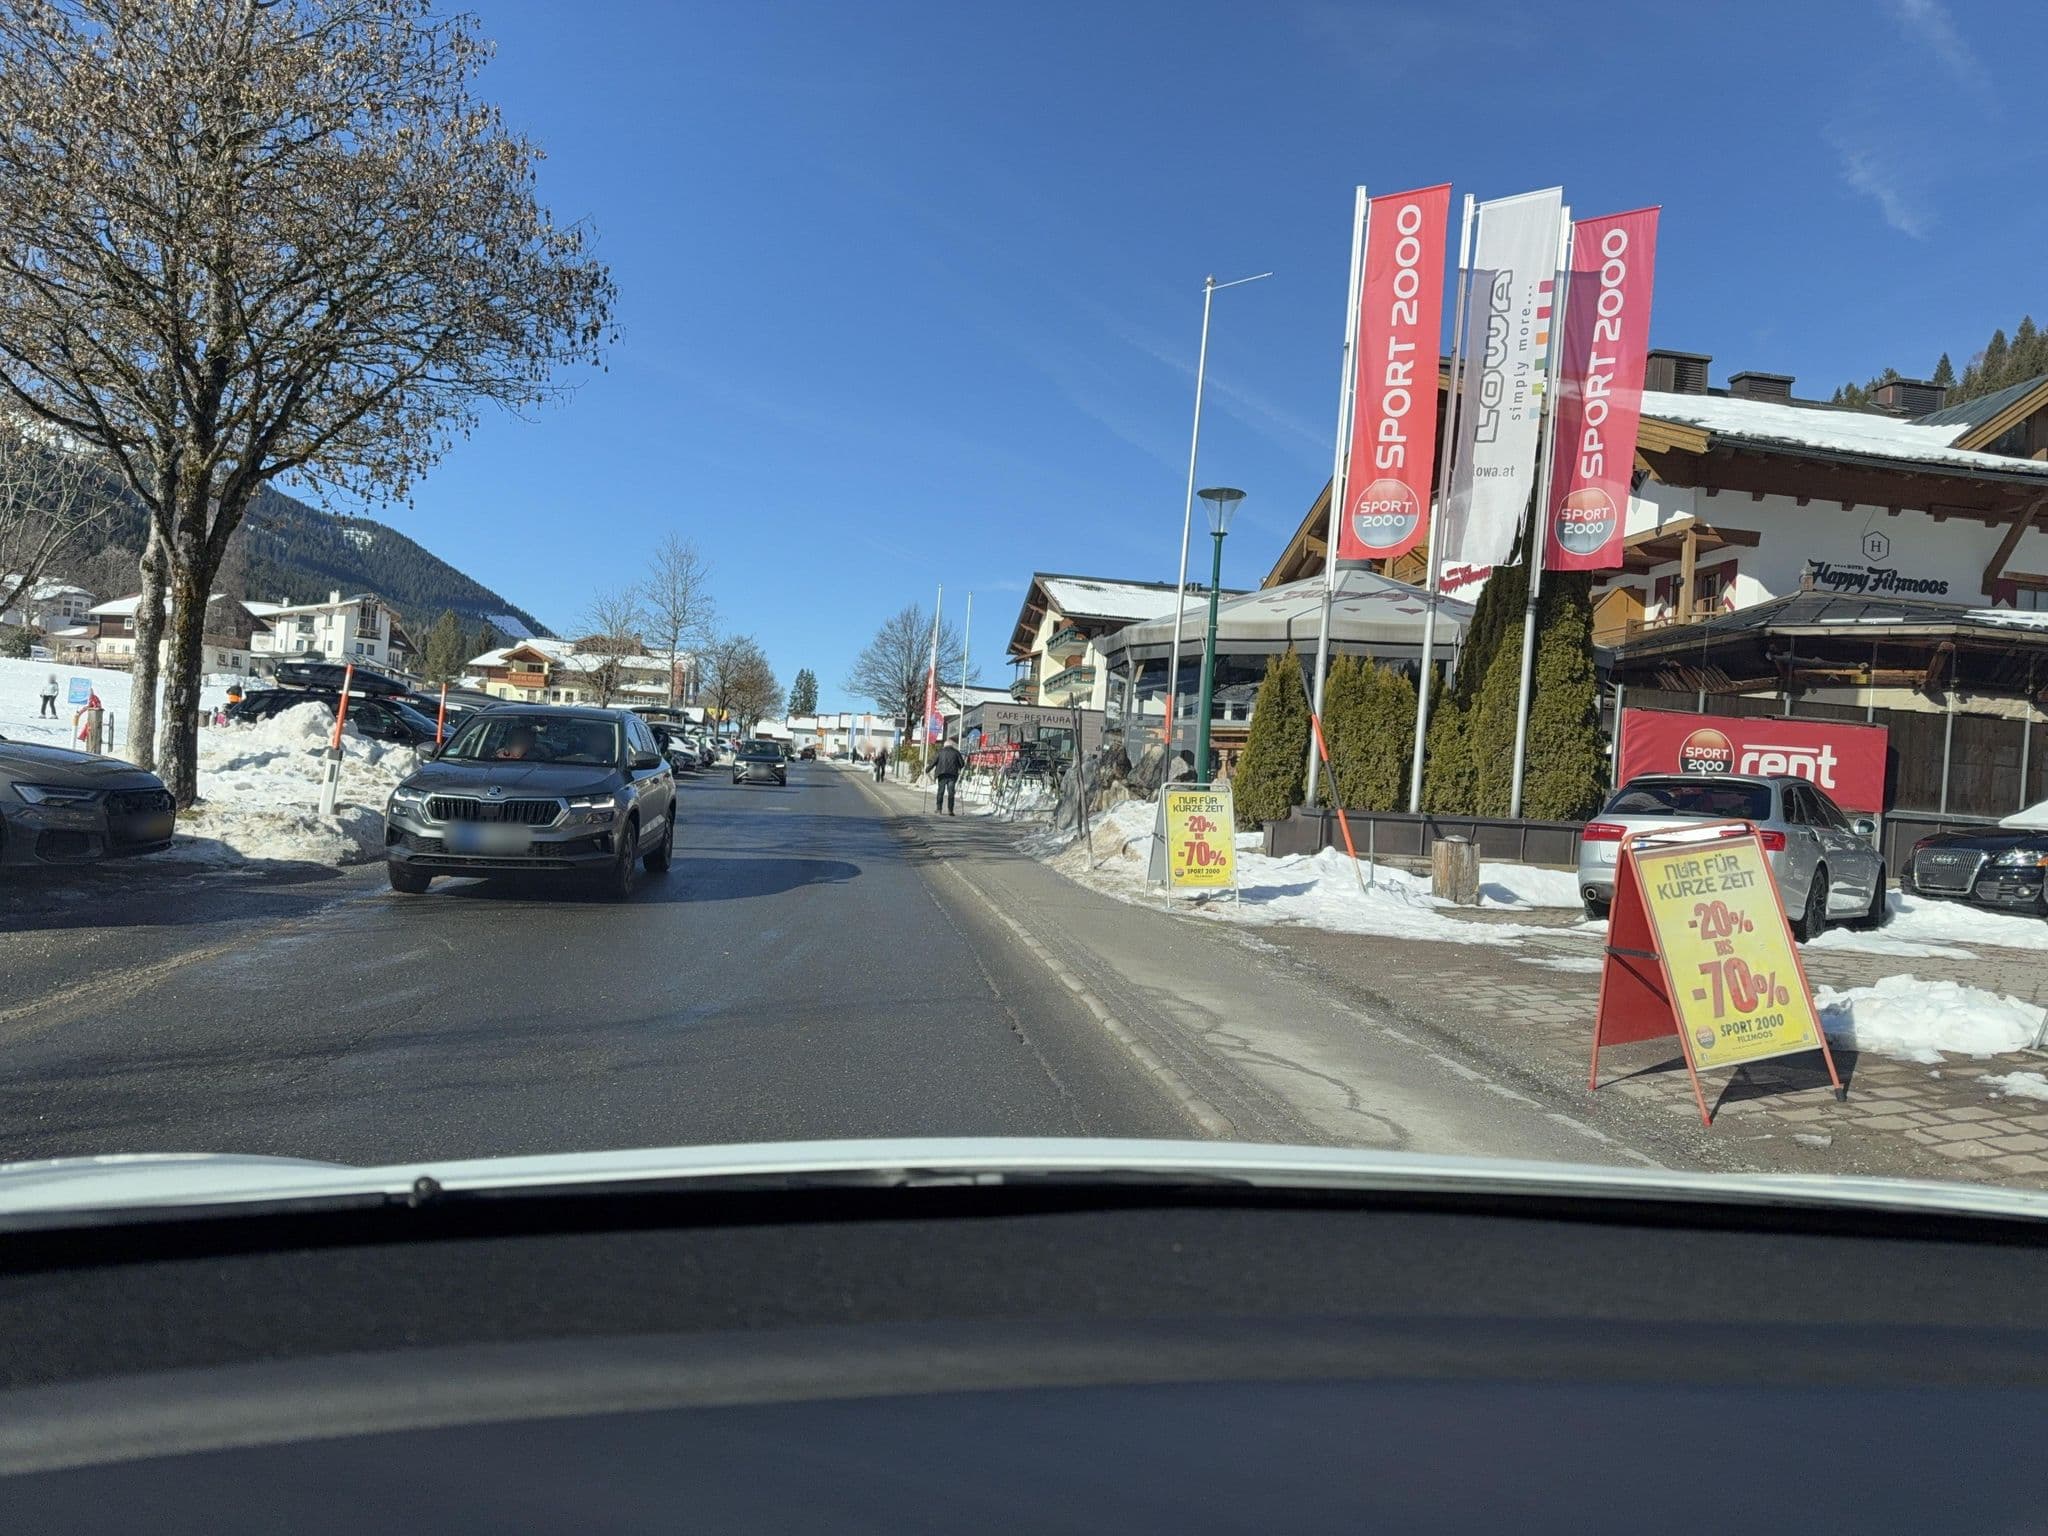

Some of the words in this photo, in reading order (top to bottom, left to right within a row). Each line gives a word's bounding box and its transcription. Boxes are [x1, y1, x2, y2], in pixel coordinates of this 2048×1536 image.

[1392, 204, 1422, 326] 2000
[1594, 228, 1629, 342] 2000
[1474, 269, 1513, 443] LOWA
[1375, 336, 1416, 469] SPORT
[1511, 362, 1529, 421] simply
[1581, 357, 1616, 479] SPORT
[1360, 500, 1413, 514] SPORT
[1561, 507, 1610, 520] SPORT
[1362, 514, 1406, 528] 2000
[1564, 522, 1604, 535] 2000
[1870, 541, 1882, 552] H
[1808, 559, 1870, 593] Happy
[1867, 566, 1949, 595] Filzmoos
[1685, 746, 1729, 759] SPORT
[1687, 759, 1724, 772] 2000
[1740, 744, 1838, 789] rent
[1173, 804, 1204, 813] KURZE
[1205, 804, 1224, 813] ZEIT
[1178, 796, 1198, 804] NUR
[1199, 795, 1218, 804] FÜR
[1184, 815, 1218, 832] -20%
[1178, 841, 1226, 866] -70%
[1664, 861, 1703, 880] NUR
[1704, 853, 1740, 875] FÜR
[1657, 877, 1718, 900] KURZE
[1718, 870, 1755, 891] ZEIT
[1688, 900, 1754, 940] -20%
[1692, 956, 1790, 1018] -70%
[1720, 1019, 1754, 1037] SPORT
[1755, 1013, 1785, 1031] 2000
